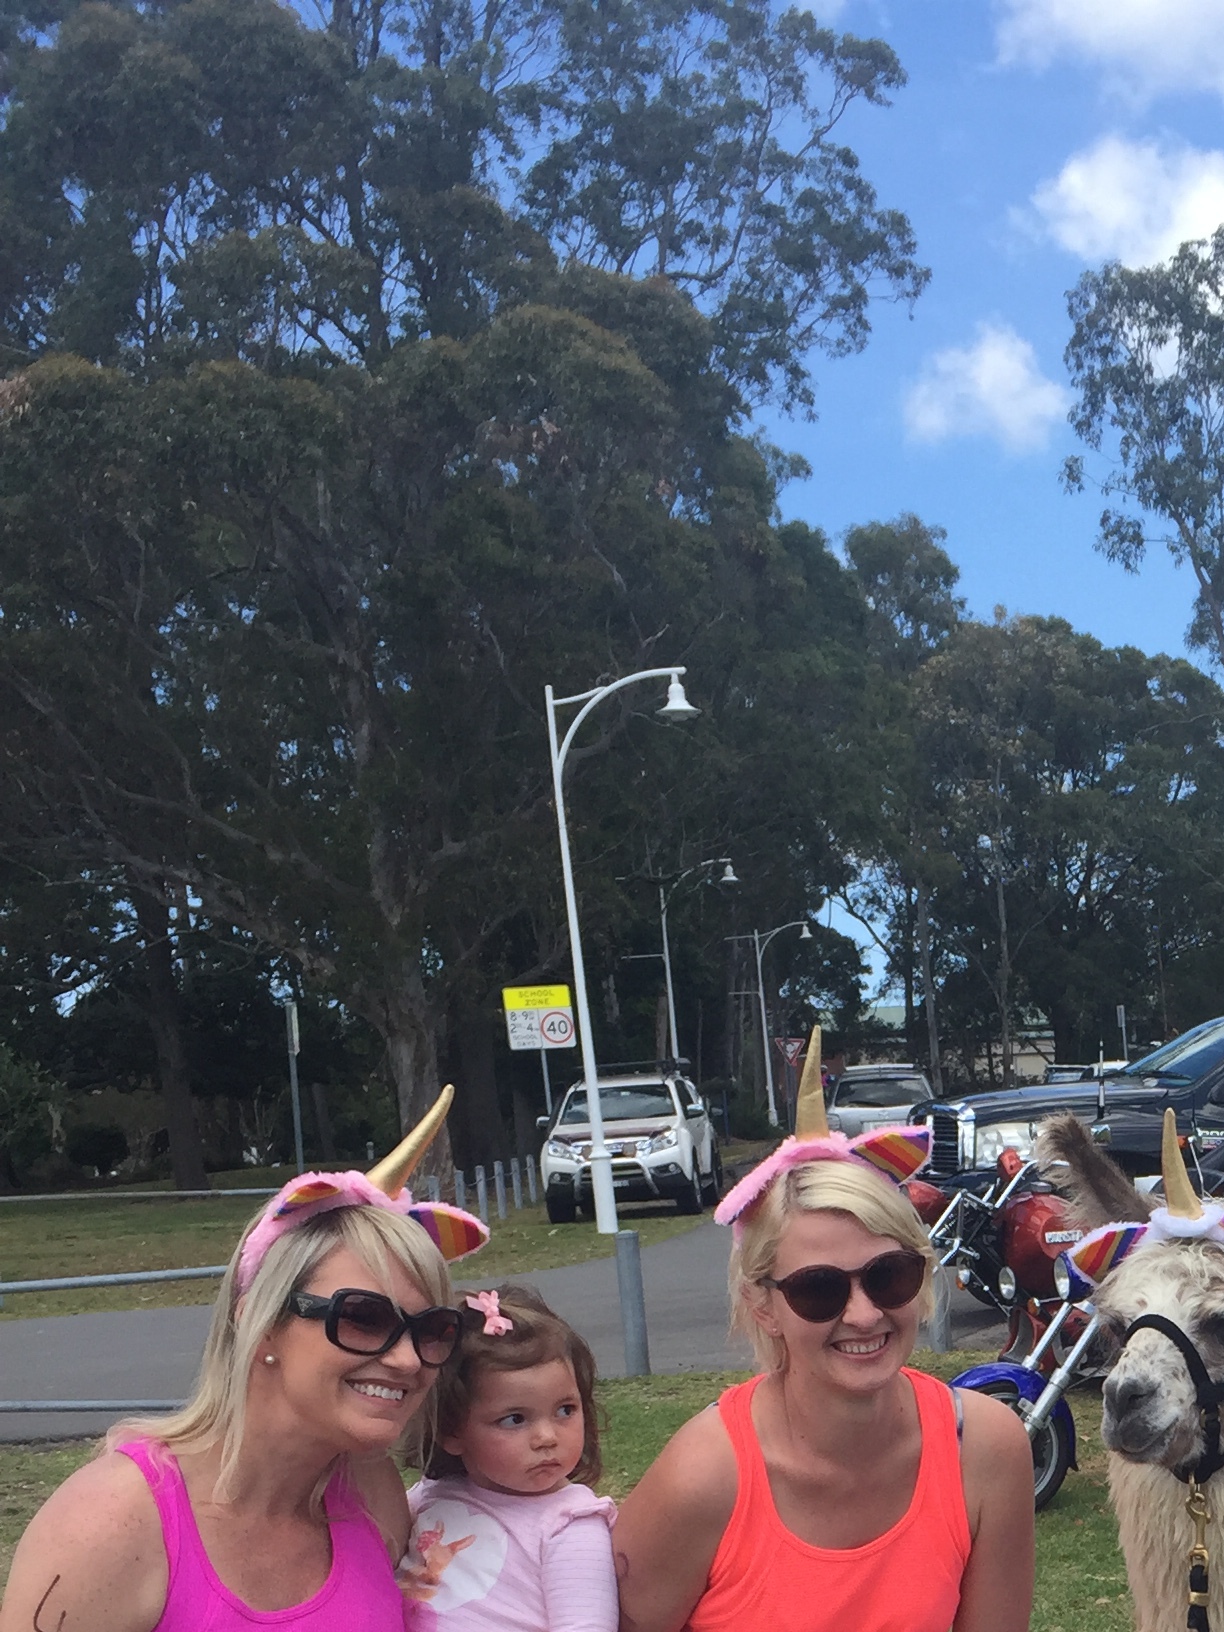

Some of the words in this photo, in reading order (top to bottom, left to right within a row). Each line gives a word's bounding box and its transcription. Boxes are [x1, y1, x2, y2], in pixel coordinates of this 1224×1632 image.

[518, 989, 555, 998] SCHOOL
[525, 998, 551, 1006] ZONE
[546, 1020, 568, 1035] 40
